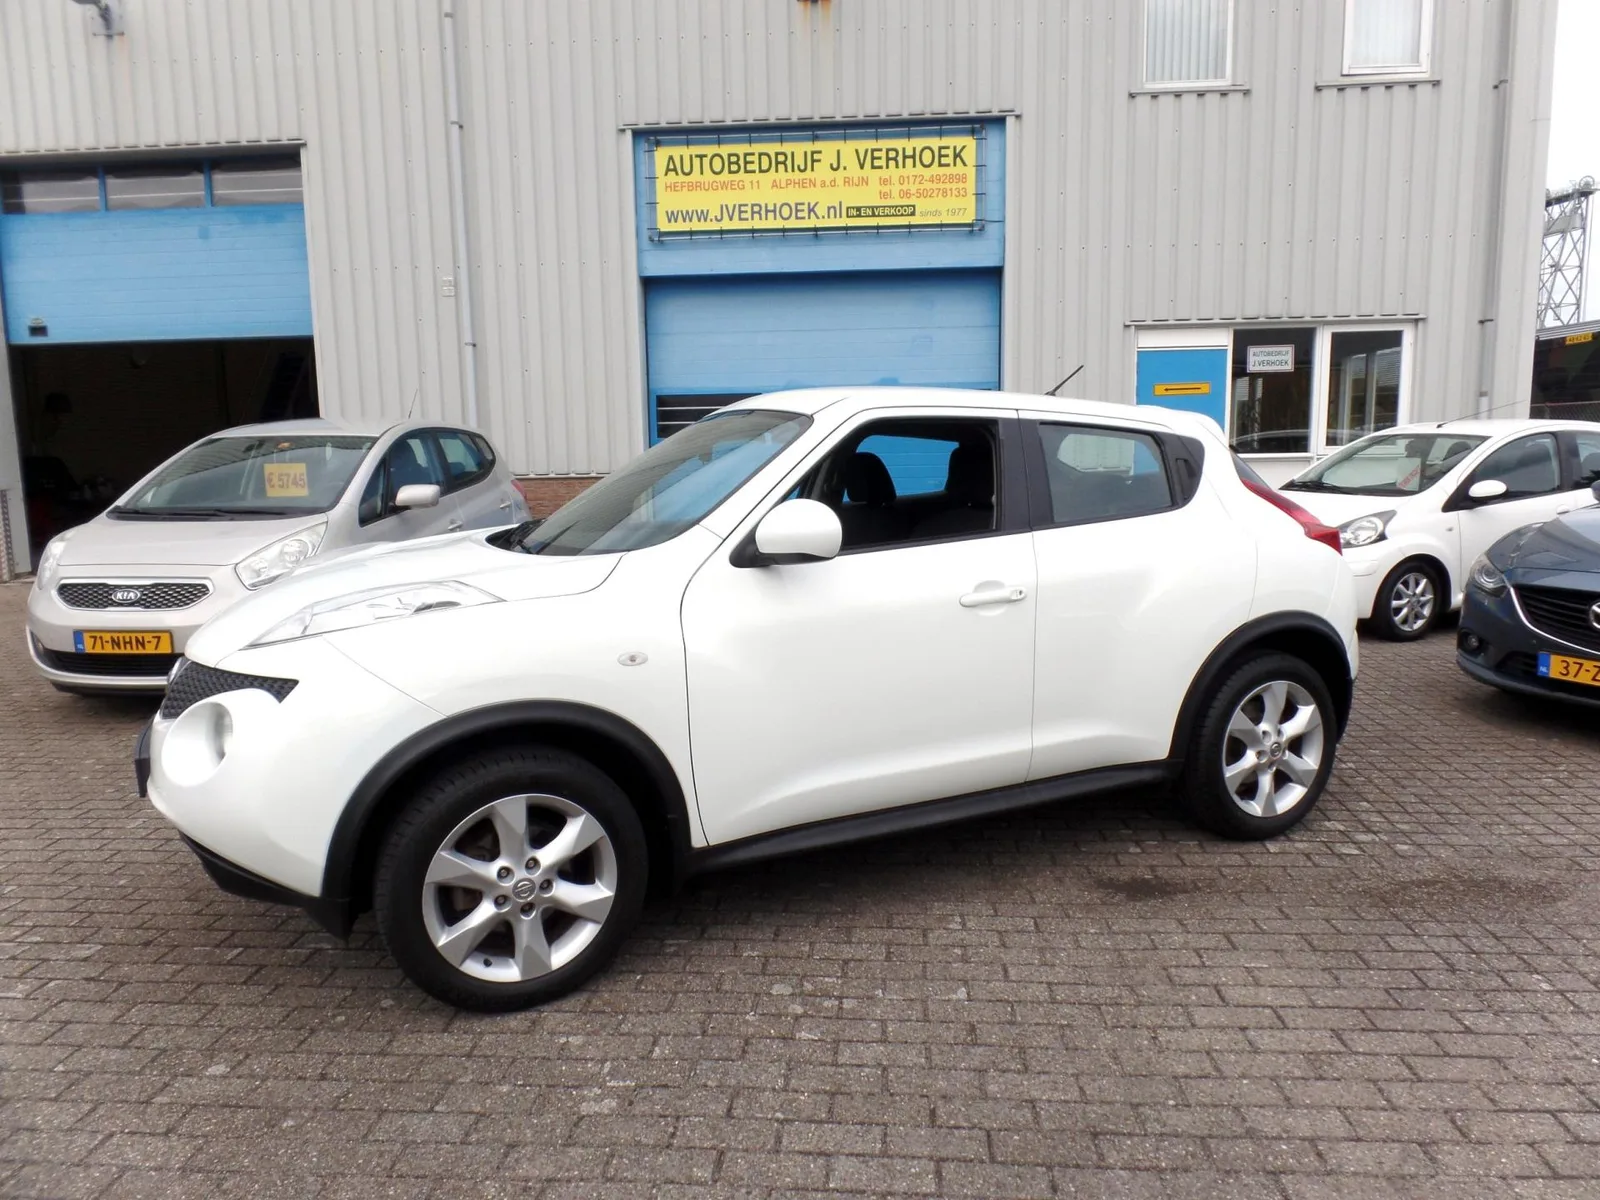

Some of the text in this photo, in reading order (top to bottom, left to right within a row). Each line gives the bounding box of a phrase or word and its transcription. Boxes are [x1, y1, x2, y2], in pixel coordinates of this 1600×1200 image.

[664, 145, 968, 177] AUTOBEDRIJF J. VERHOEK
[664, 173, 968, 193] HEFBRUGWEG 11 ALPHEN a.d. RIJN tel. 0172-492898
[879, 187, 968, 200] tel. 06-50278133
[665, 200, 843, 224] www.JVERHOEK.nl
[861, 207, 873, 216] EN
[873, 206, 914, 216] VERKOOP
[919, 208, 942, 217] sinds
[946, 207, 967, 217] 1977
[277, 472, 306, 489] 5745
[116, 591, 135, 600] KIA
[89, 635, 162, 651] 71-NHN-7
